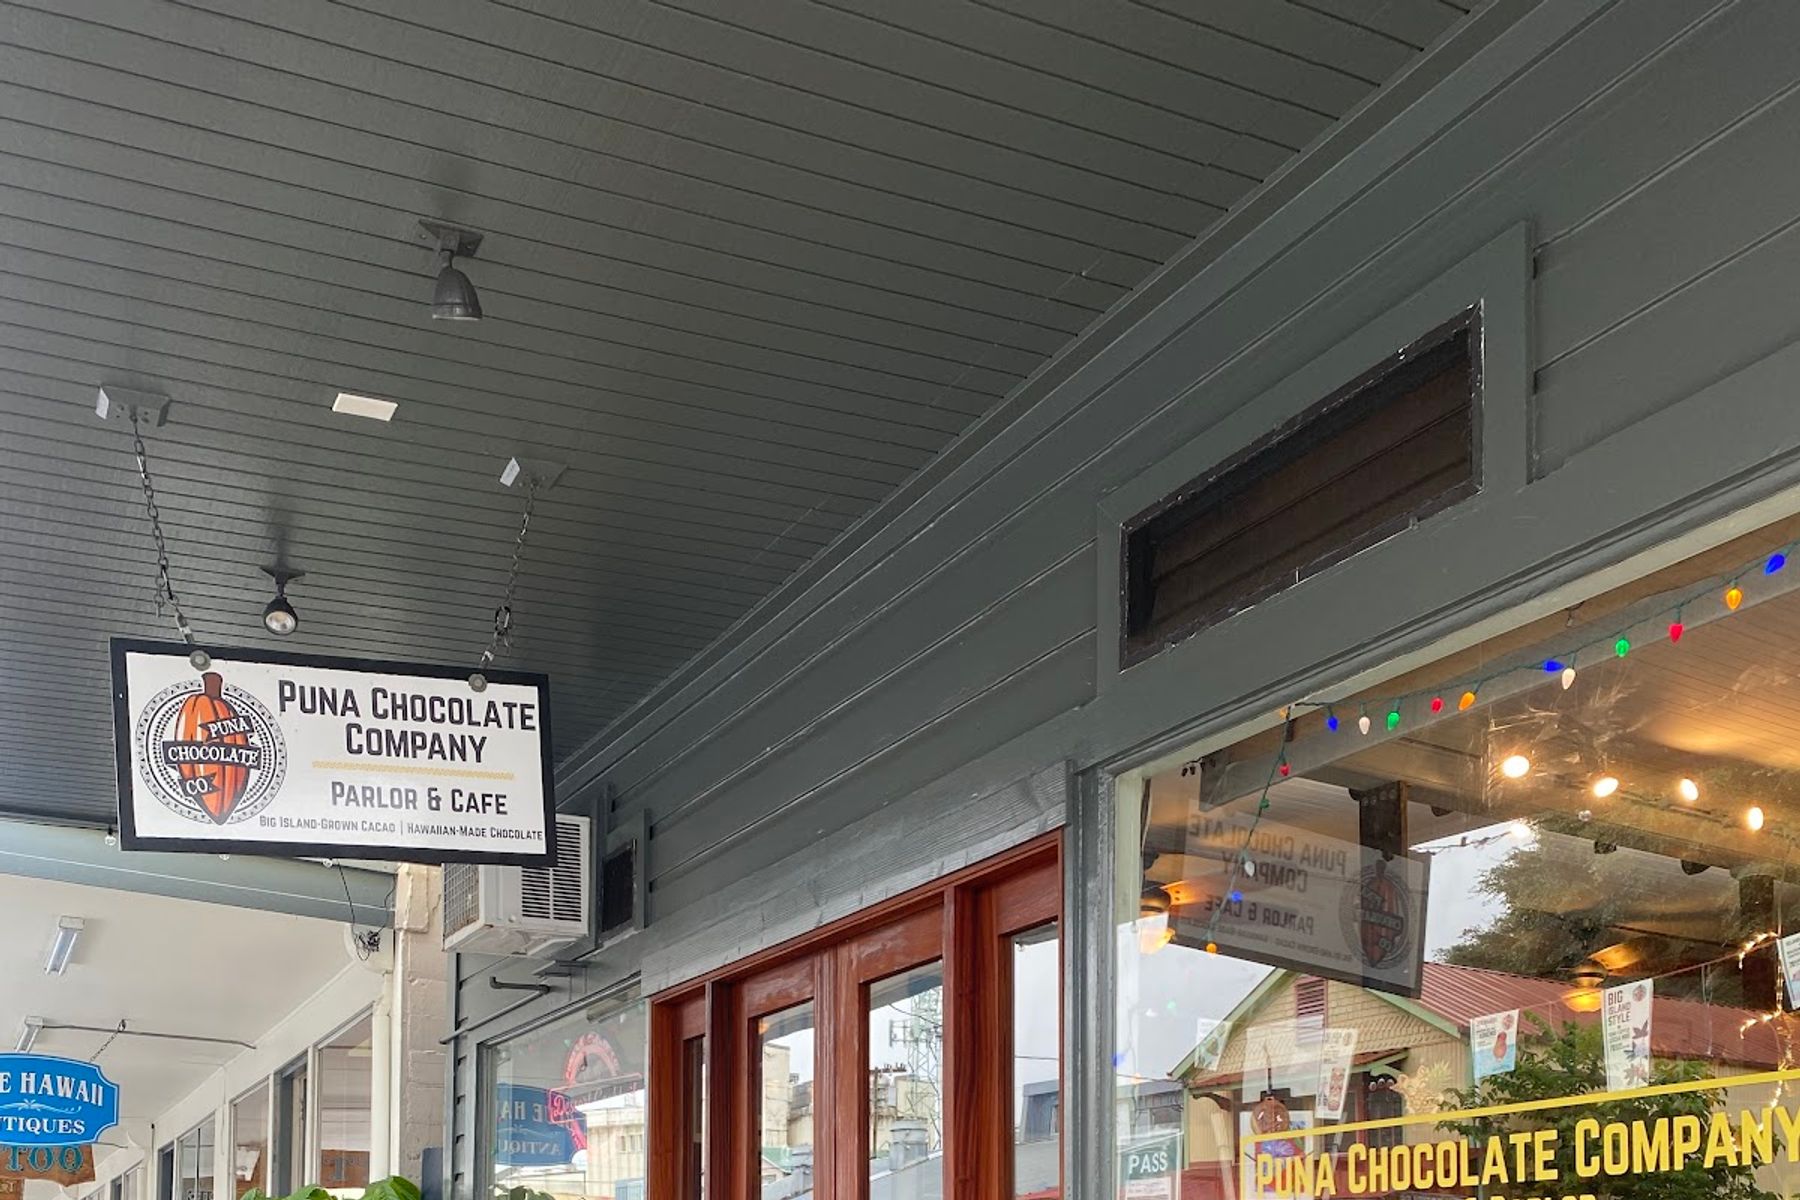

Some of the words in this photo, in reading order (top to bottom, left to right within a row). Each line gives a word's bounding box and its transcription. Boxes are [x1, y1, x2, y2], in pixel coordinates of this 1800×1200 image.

[278, 679, 361, 718] PUNA
[371, 687, 537, 731] CHOCOLATE
[208, 717, 250, 738] PUNA
[345, 722, 488, 763] COMPANY
[168, 746, 259, 768] CHOCOLATE
[186, 778, 213, 796] CO.
[331, 781, 418, 810] PARLOR
[427, 787, 443, 812] &
[451, 788, 509, 816] CAFE
[259, 815, 277, 829] BIG
[279, 816, 359, 832] ISLAND-GROWN
[361, 820, 396, 834] CACAO
[407, 822, 487, 838] HAWAIIAN-MADE
[490, 826, 544, 841] CHOCOLATE
[1608, 990, 1624, 1006] BIG
[1608, 1011, 1632, 1027] STYLE
[0, 1072, 11, 1094] E
[19, 1072, 104, 1107] HAWAII
[0, 1115, 85, 1135] TIQUES
[0, 1146, 84, 1172] TOO
[1127, 1151, 1169, 1174] PASS
[1256, 1152, 1336, 1199] PUNA
[1348, 1129, 1559, 1194] CHOCOLATE
[1575, 1105, 1800, 1178] COMPANY
